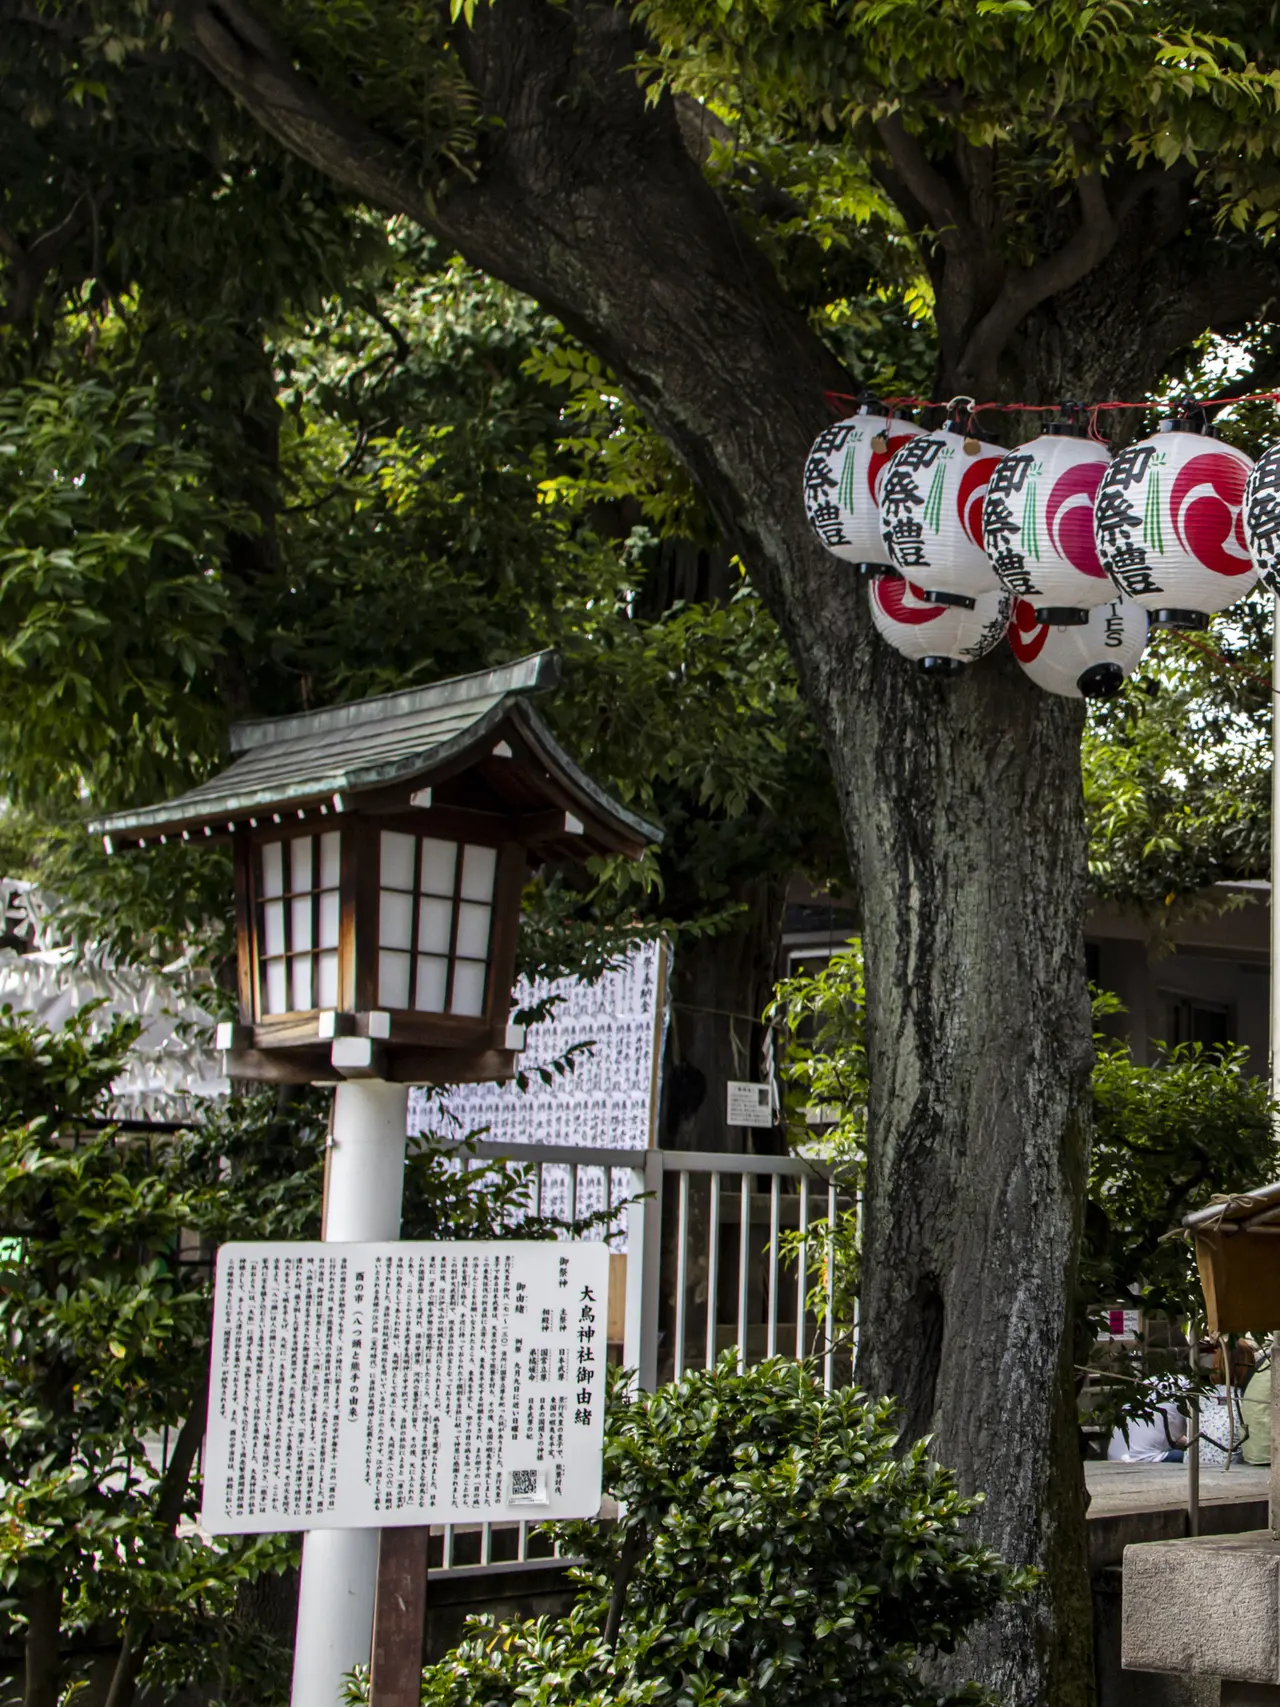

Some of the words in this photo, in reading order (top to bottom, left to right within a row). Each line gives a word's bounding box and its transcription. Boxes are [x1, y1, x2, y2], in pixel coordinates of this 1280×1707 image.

[1095, 445, 1164, 597] 御祭禮
[515, 1282, 526, 1315] 御由緒
[558, 1256, 570, 1289] 御祭神
[574, 1285, 597, 1426] 大鳥神社御由緒
